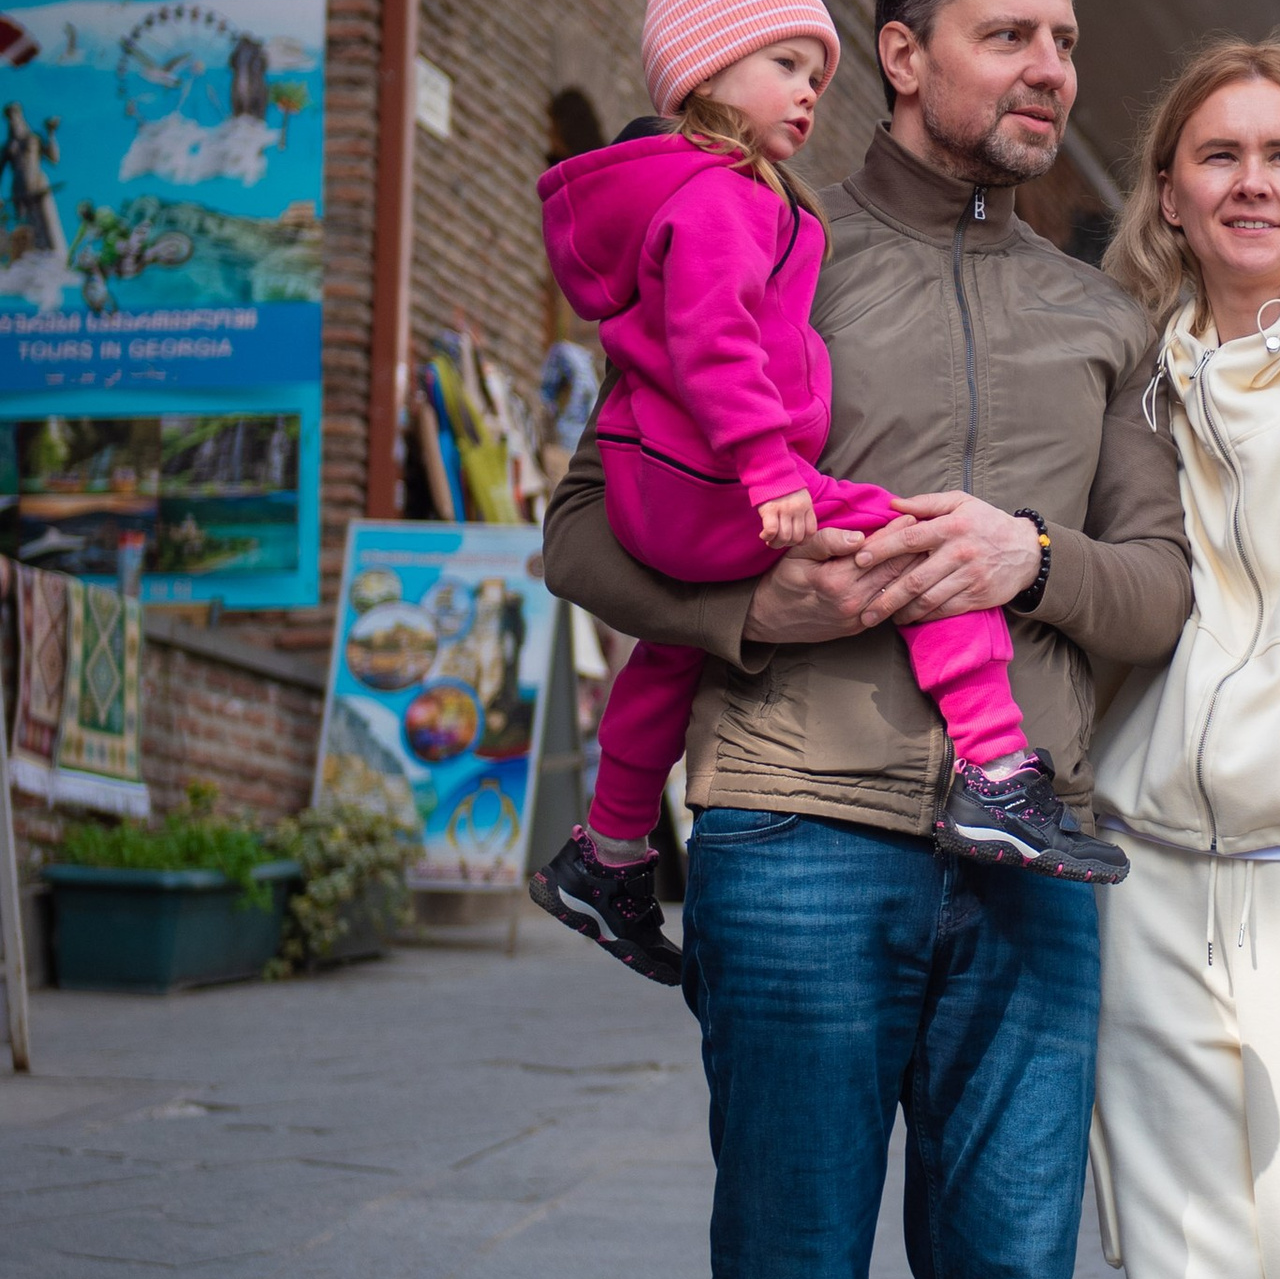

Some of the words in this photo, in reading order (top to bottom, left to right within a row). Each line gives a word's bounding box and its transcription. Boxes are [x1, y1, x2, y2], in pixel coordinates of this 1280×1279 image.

[19, 340, 93, 362] TOURS
[100, 341, 121, 360] IN
[129, 338, 232, 359] GEORGIA
